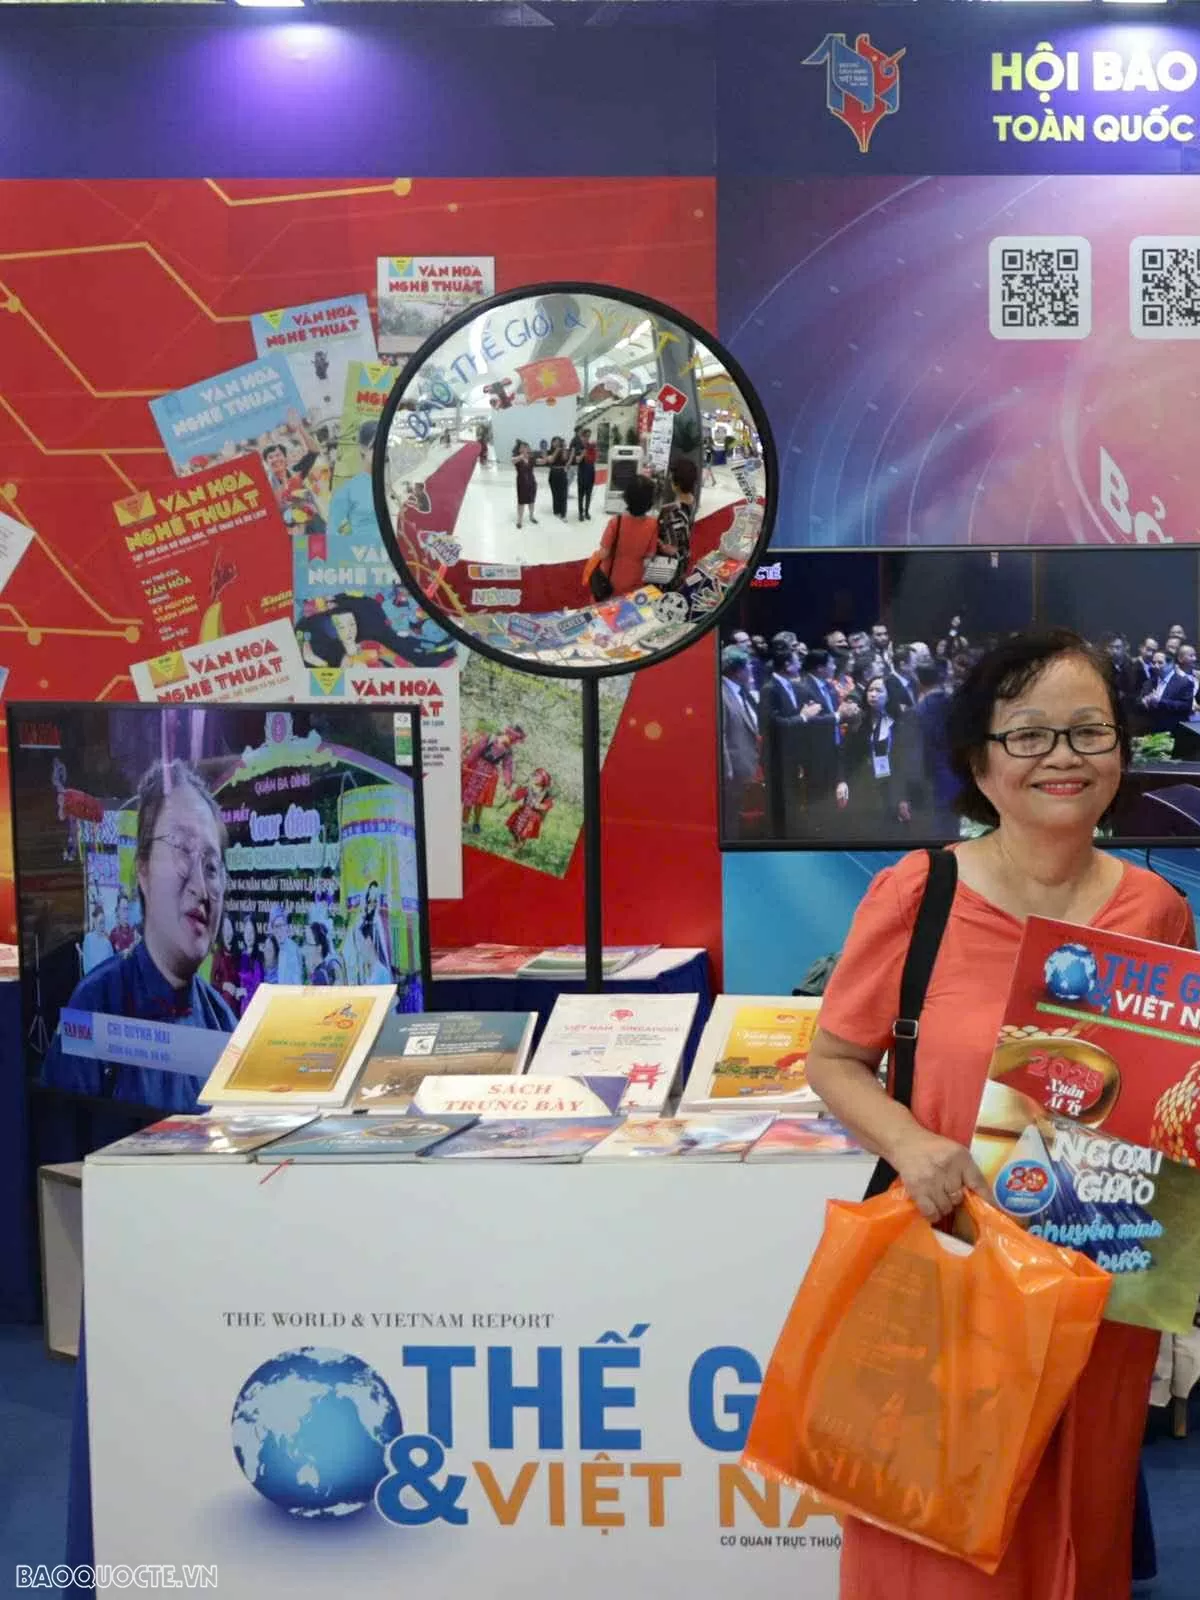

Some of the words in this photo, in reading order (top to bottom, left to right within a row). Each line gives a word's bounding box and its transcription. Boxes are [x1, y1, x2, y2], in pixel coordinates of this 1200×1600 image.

[991, 41, 1079, 103] HỘI
[993, 108, 1085, 142] TOÀN
[1092, 105, 1195, 143] QUỐC
[1100, 953, 1176, 997] THẾ
[1114, 989, 1175, 1021] VIỆT
[535, 1097, 584, 1112] BÀY
[222, 1311, 266, 1327] THE
[270, 1311, 347, 1328] WORLD
[351, 1312, 366, 1327] &
[371, 1312, 464, 1328] VIETNAM
[471, 1312, 555, 1328] REPORT
[402, 1323, 652, 1450] THẾ
[377, 1433, 469, 1526] &
[472, 1451, 683, 1537] VIỆT
[720, 1535, 737, 1547] CƠ
[739, 1535, 773, 1547] QUAN
[776, 1535, 807, 1549] TRỰC
[809, 1533, 843, 1549] THUỘ
